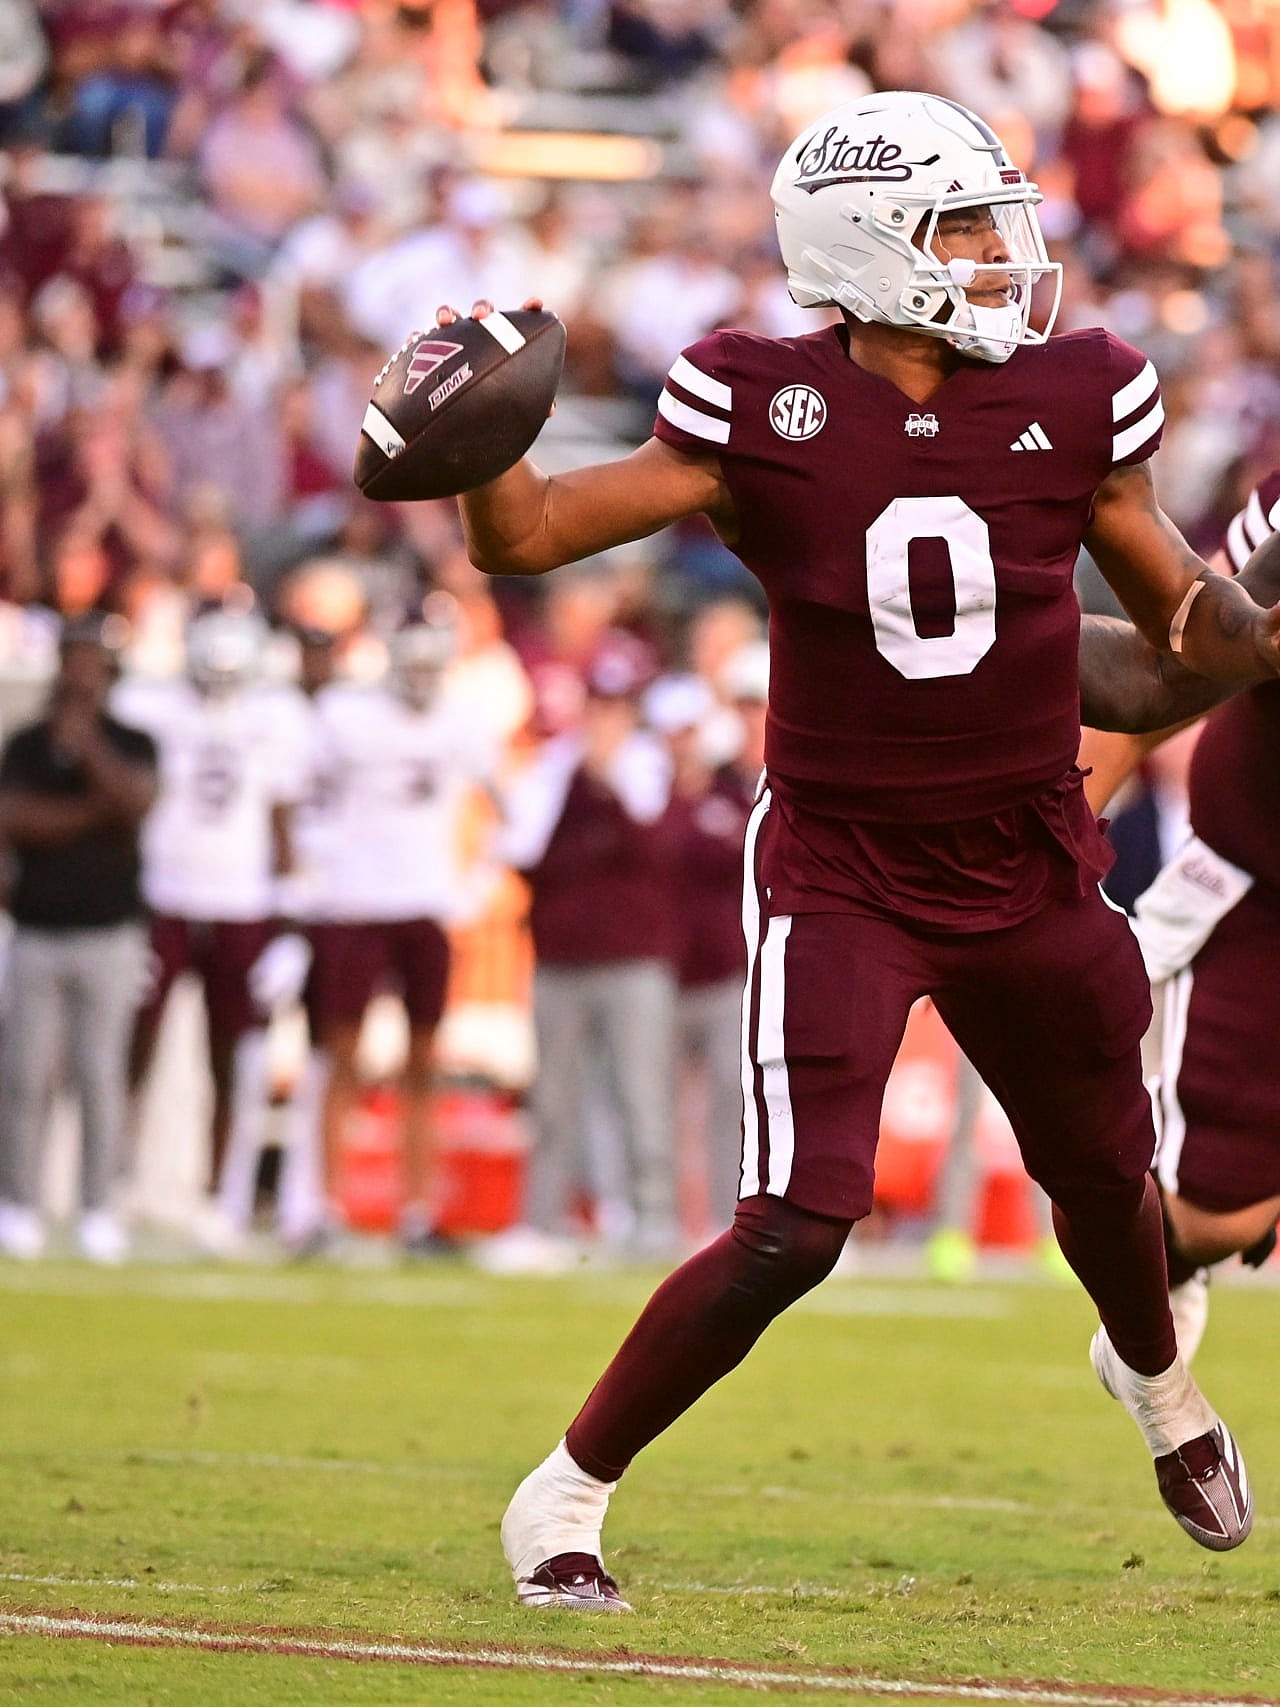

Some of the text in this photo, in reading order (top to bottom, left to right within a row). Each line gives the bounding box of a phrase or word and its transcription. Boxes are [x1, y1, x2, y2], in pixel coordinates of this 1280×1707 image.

[796, 126, 915, 190] State
[774, 387, 823, 438] SEC
[865, 495, 997, 680] 0
